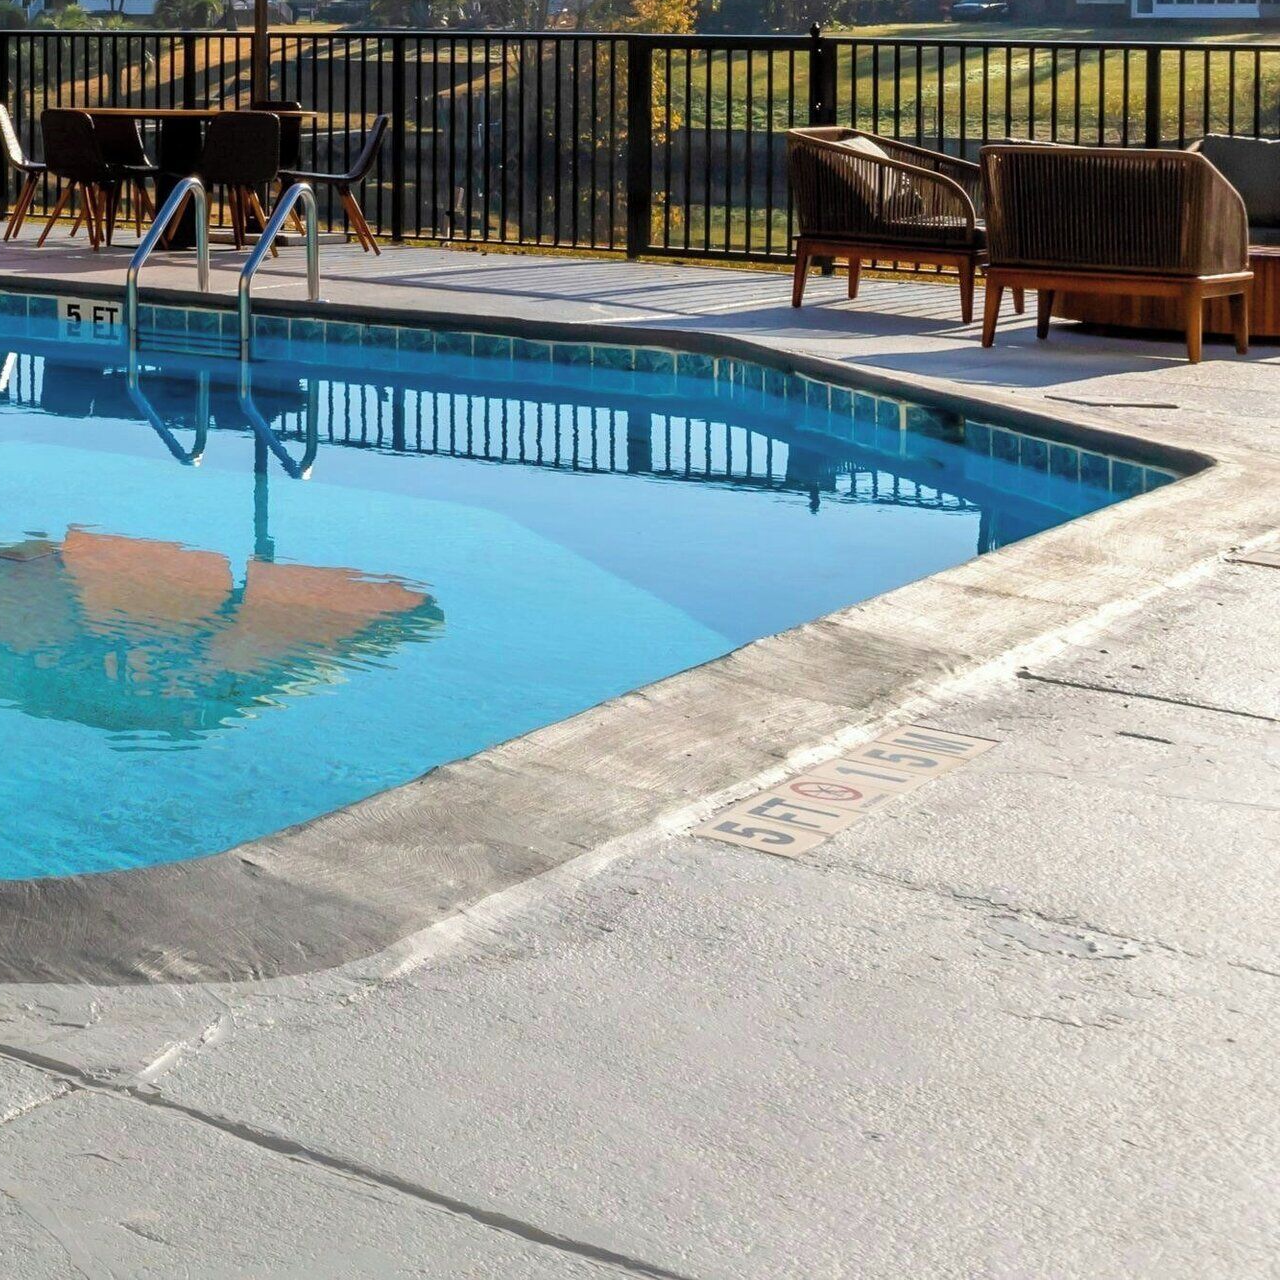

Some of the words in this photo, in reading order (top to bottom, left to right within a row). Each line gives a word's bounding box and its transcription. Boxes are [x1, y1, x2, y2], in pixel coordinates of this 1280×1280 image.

[66, 303, 82, 323] 5
[92, 305, 119, 324] FT
[893, 731, 975, 755] M
[747, 796, 840, 829] FT
[713, 821, 795, 845] 5
